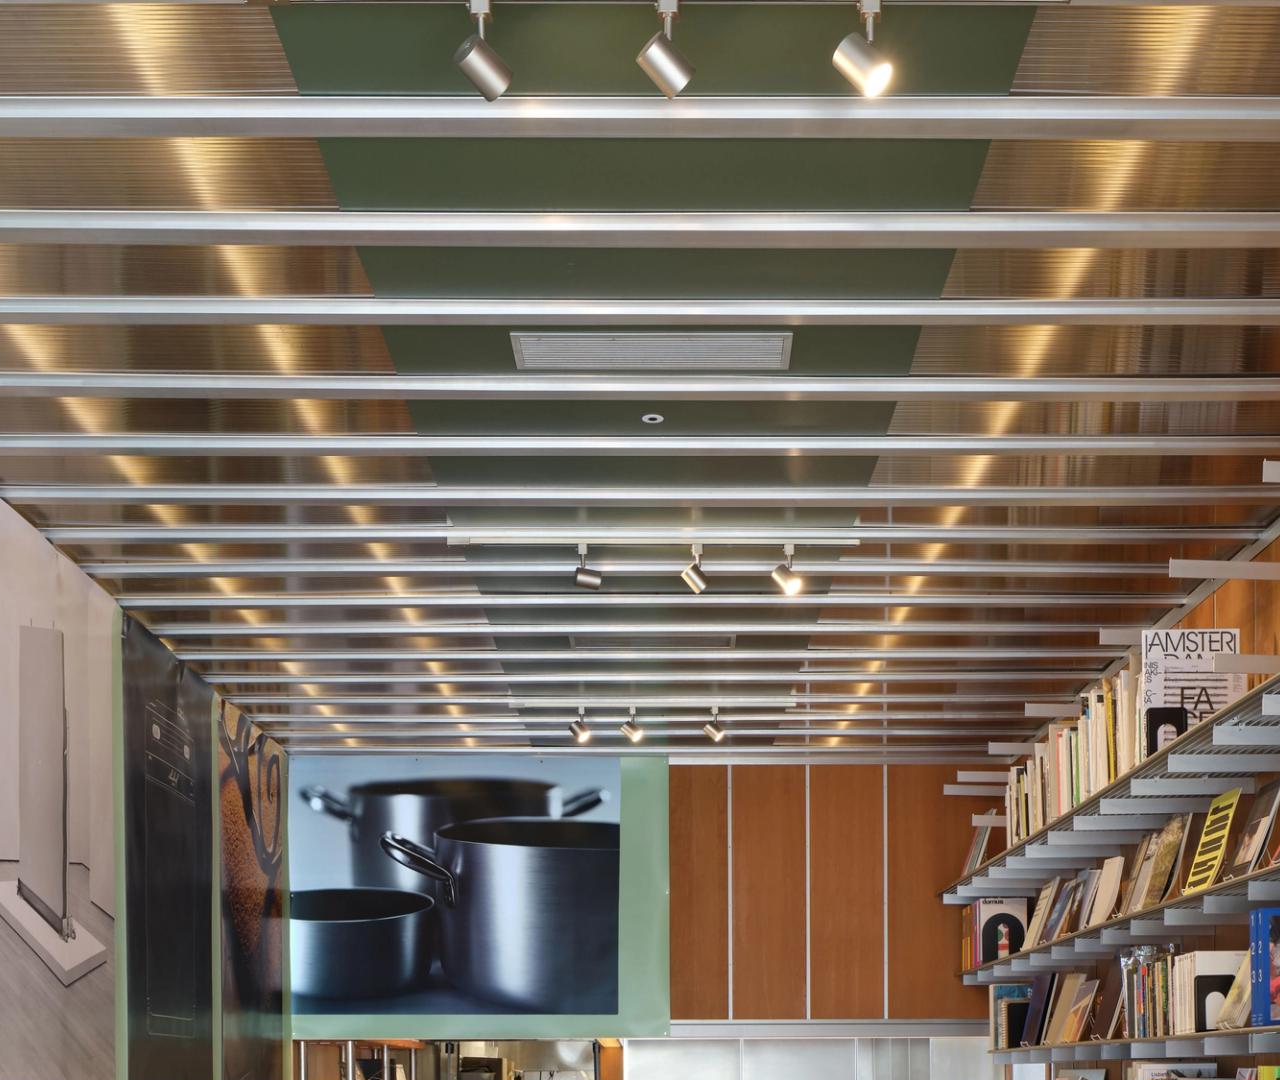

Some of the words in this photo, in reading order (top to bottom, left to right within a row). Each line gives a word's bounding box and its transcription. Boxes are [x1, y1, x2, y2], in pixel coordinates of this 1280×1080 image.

[1148, 632, 1234, 652] AMSTER
[1181, 688, 1214, 710] FA
[1251, 915, 1254, 926] 1
[1258, 912, 1261, 924] 1
[1251, 942, 1255, 955] 2
[1258, 940, 1262, 954] 2
[1252, 970, 1256, 983] 3
[1258, 970, 1262, 982] 3
